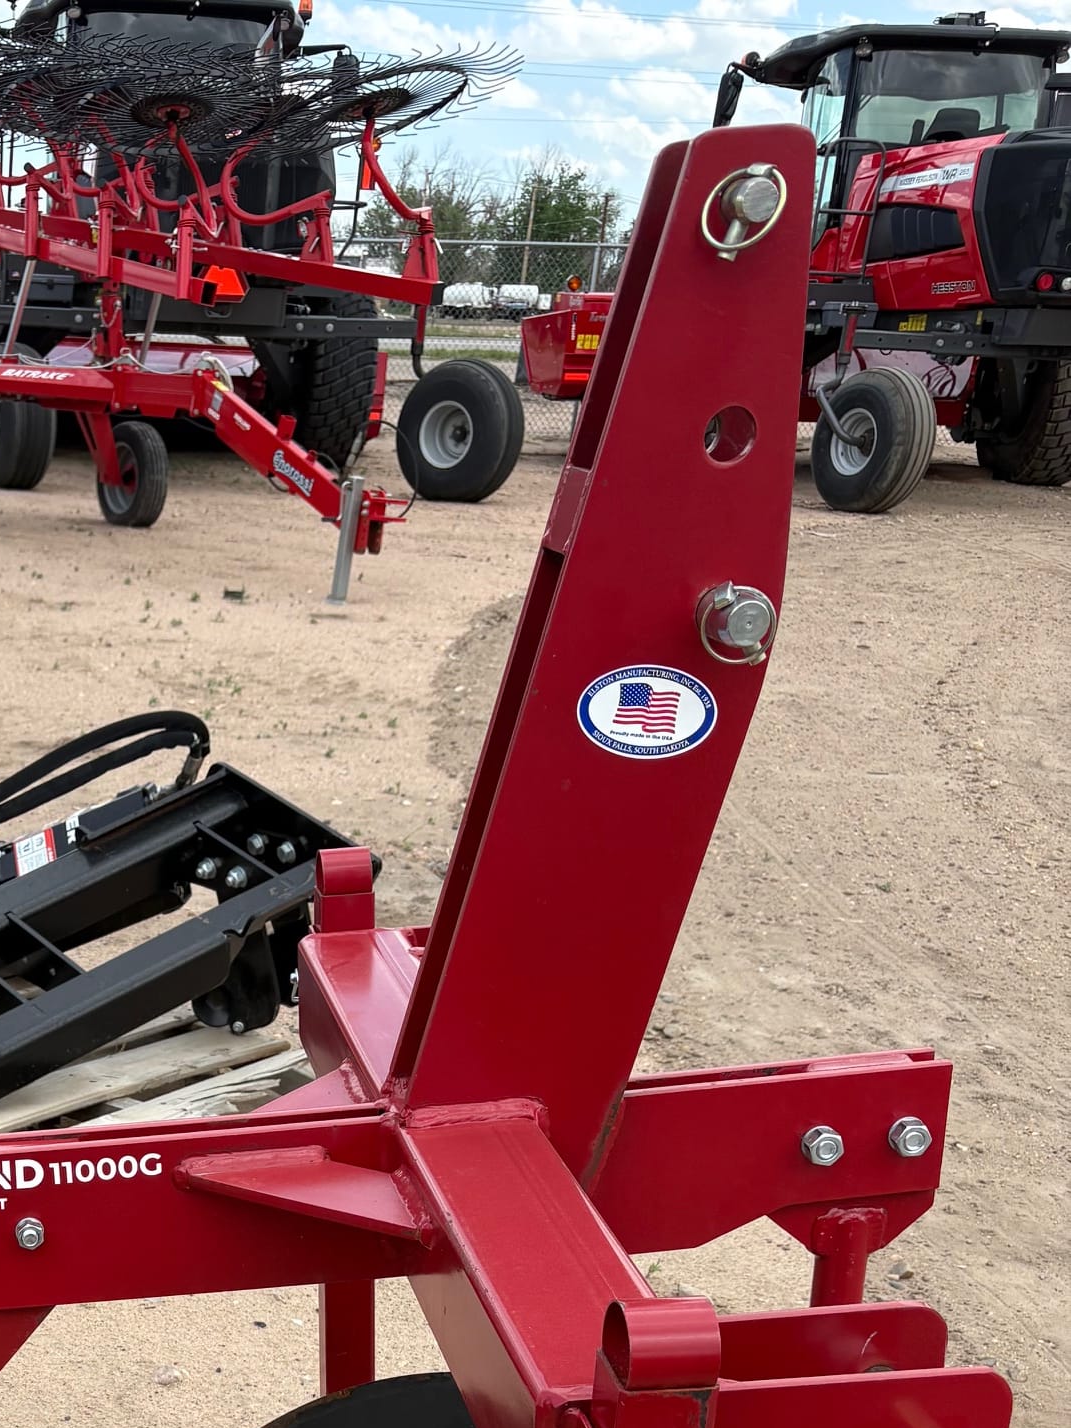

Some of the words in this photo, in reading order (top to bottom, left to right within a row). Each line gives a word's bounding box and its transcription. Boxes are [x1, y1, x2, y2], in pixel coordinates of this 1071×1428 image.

[931, 280, 976, 294] HESSTON
[587, 675, 614, 697] ELSTON
[592, 729, 611, 746] SIOUX
[634, 745, 659, 755] SOUTH
[660, 740, 690, 753] DAKOTA
[48, 1152, 164, 1186] 11000G
